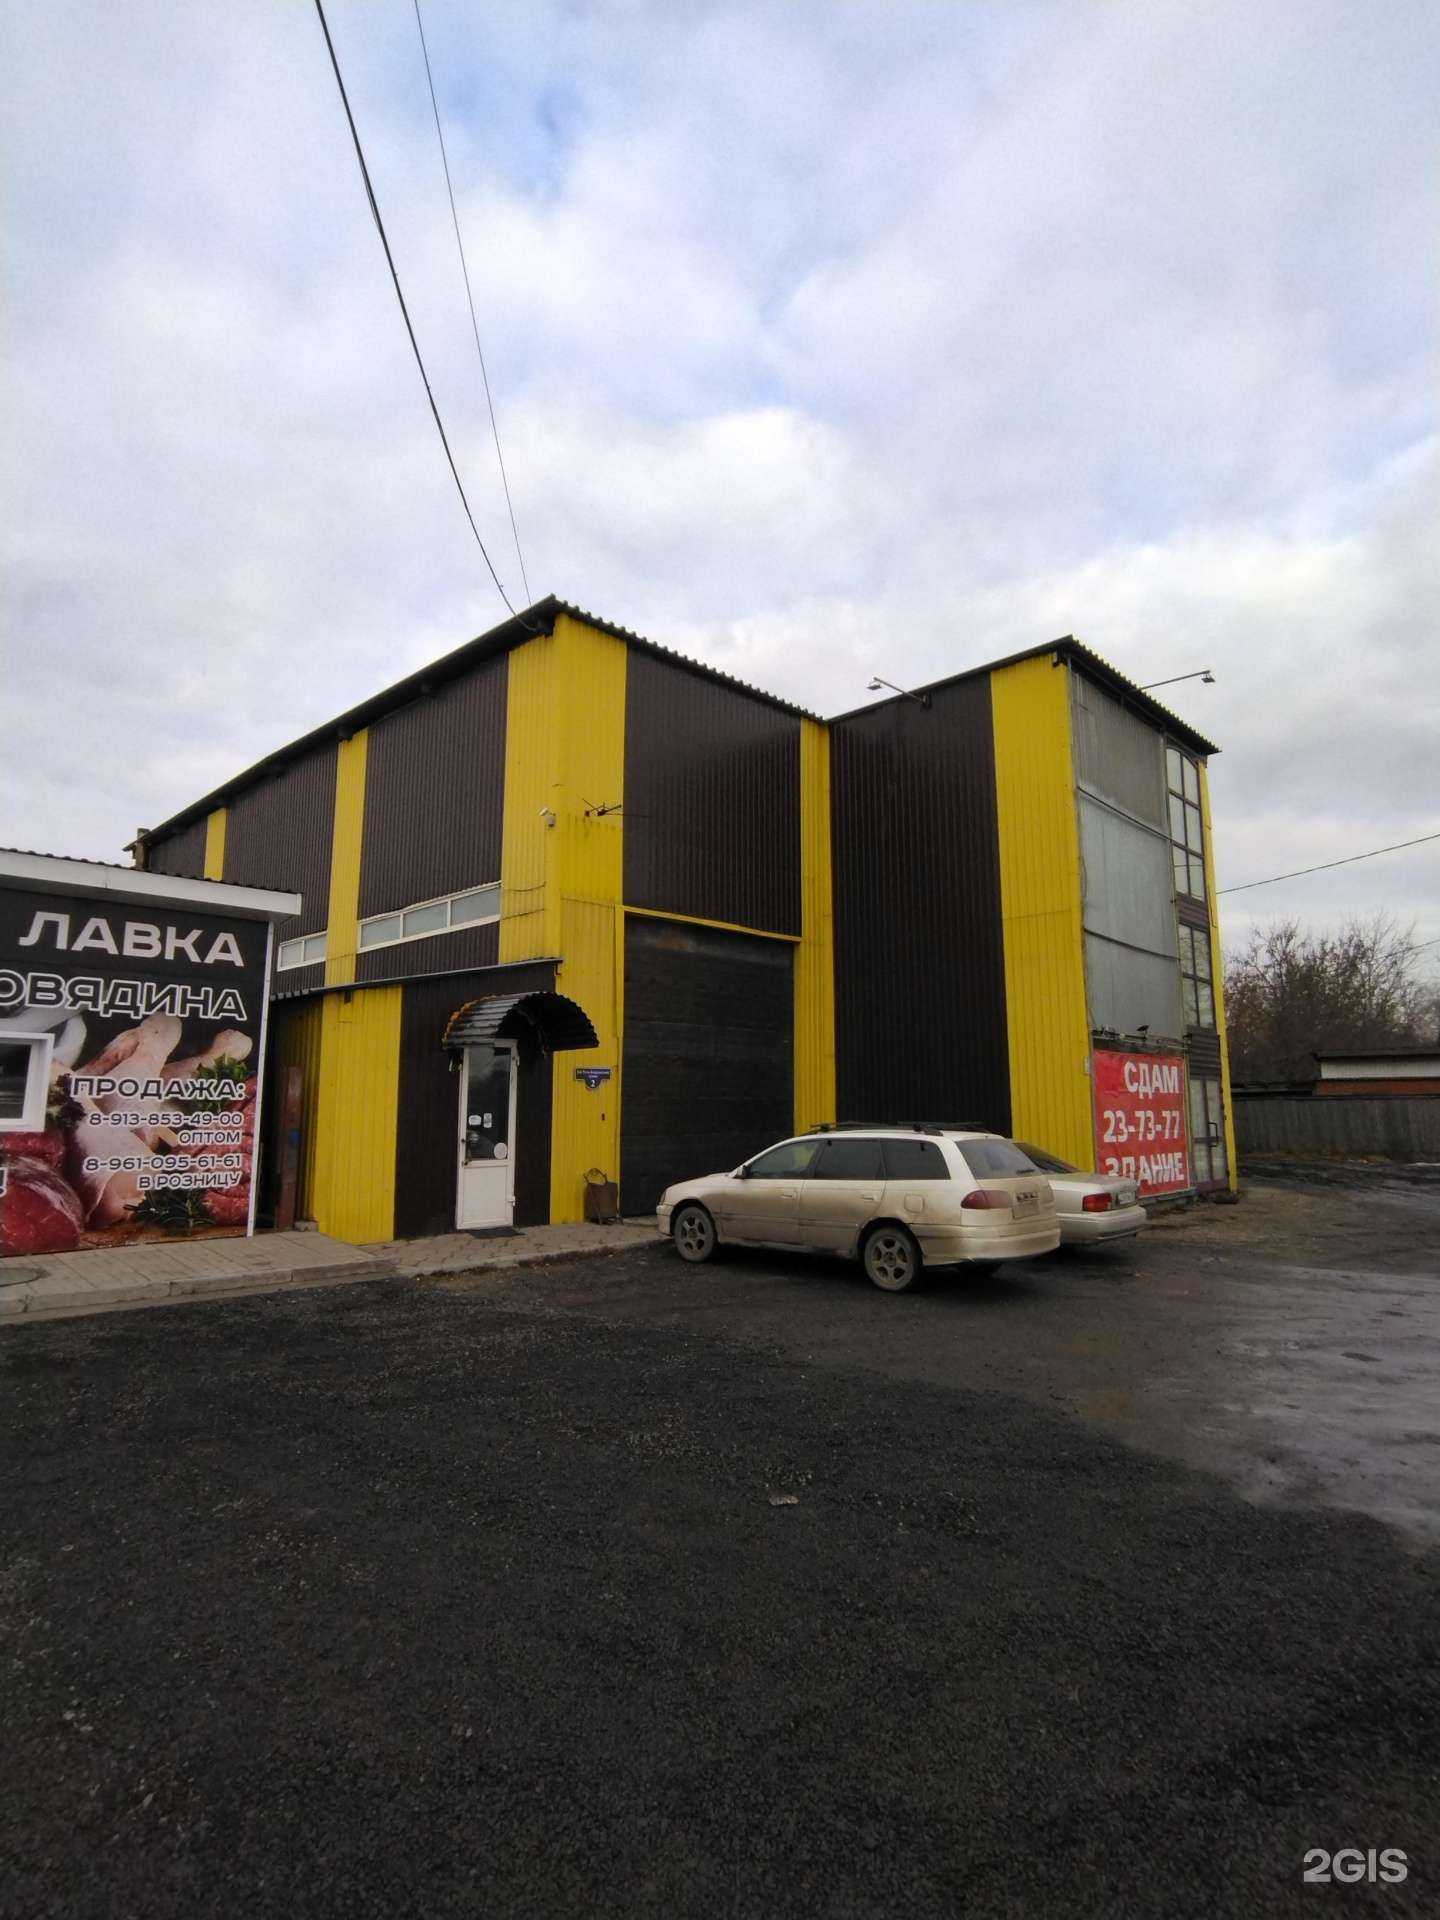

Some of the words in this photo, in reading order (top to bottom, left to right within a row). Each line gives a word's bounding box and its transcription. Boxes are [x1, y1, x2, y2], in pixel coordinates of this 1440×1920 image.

[18, 911, 245, 967] ЛАВКА
[71, 1075, 246, 1100] ПРОДАЖА:
[1124, 1060, 1179, 1099] СДАМ
[88, 1112, 243, 1127] 8-913-853-49-00
[1103, 1110, 1180, 1143] 23-73-77
[178, 1131, 241, 1144] ОПТОМ
[85, 1154, 241, 1171] 8-961-095-61-61
[138, 1176, 151, 1189] В
[156, 1172, 241, 1189] РОЗНИЦУ
